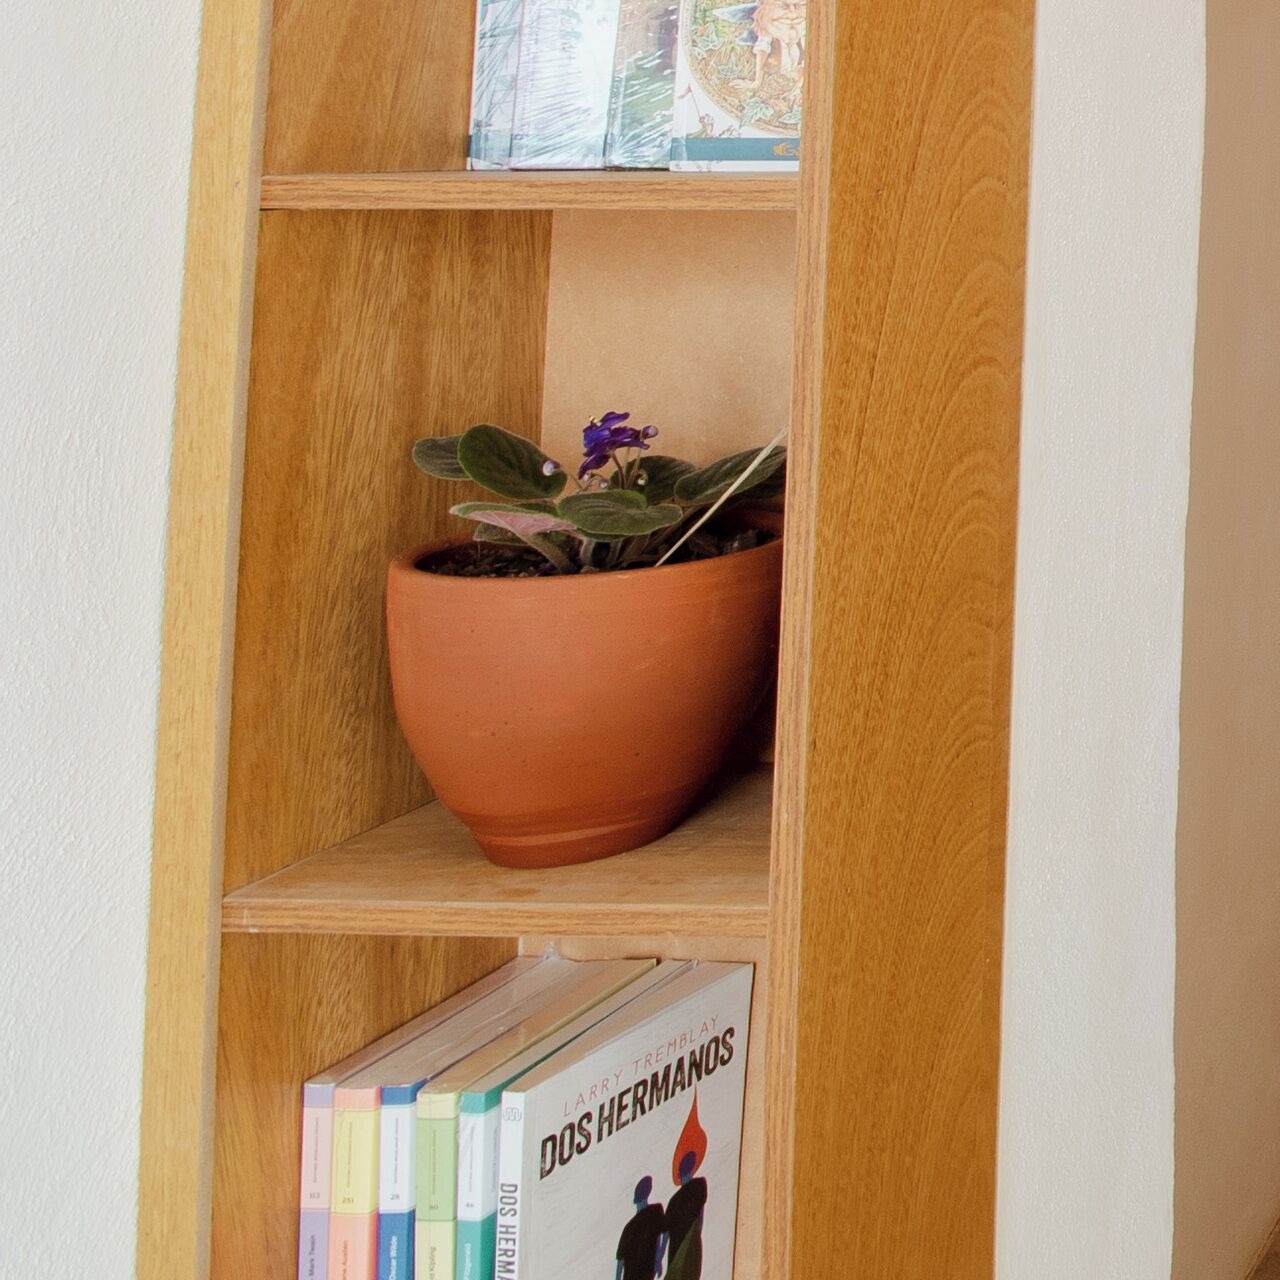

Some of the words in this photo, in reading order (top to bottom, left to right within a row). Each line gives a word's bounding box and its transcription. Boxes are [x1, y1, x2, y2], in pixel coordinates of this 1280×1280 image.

[539, 1110, 593, 1181] DOS
[596, 1025, 736, 1145] HERMANOS
[563, 1069, 624, 1117] LARRY
[632, 1013, 720, 1076] TREMBLAY
[499, 1182, 519, 1218] DOS
